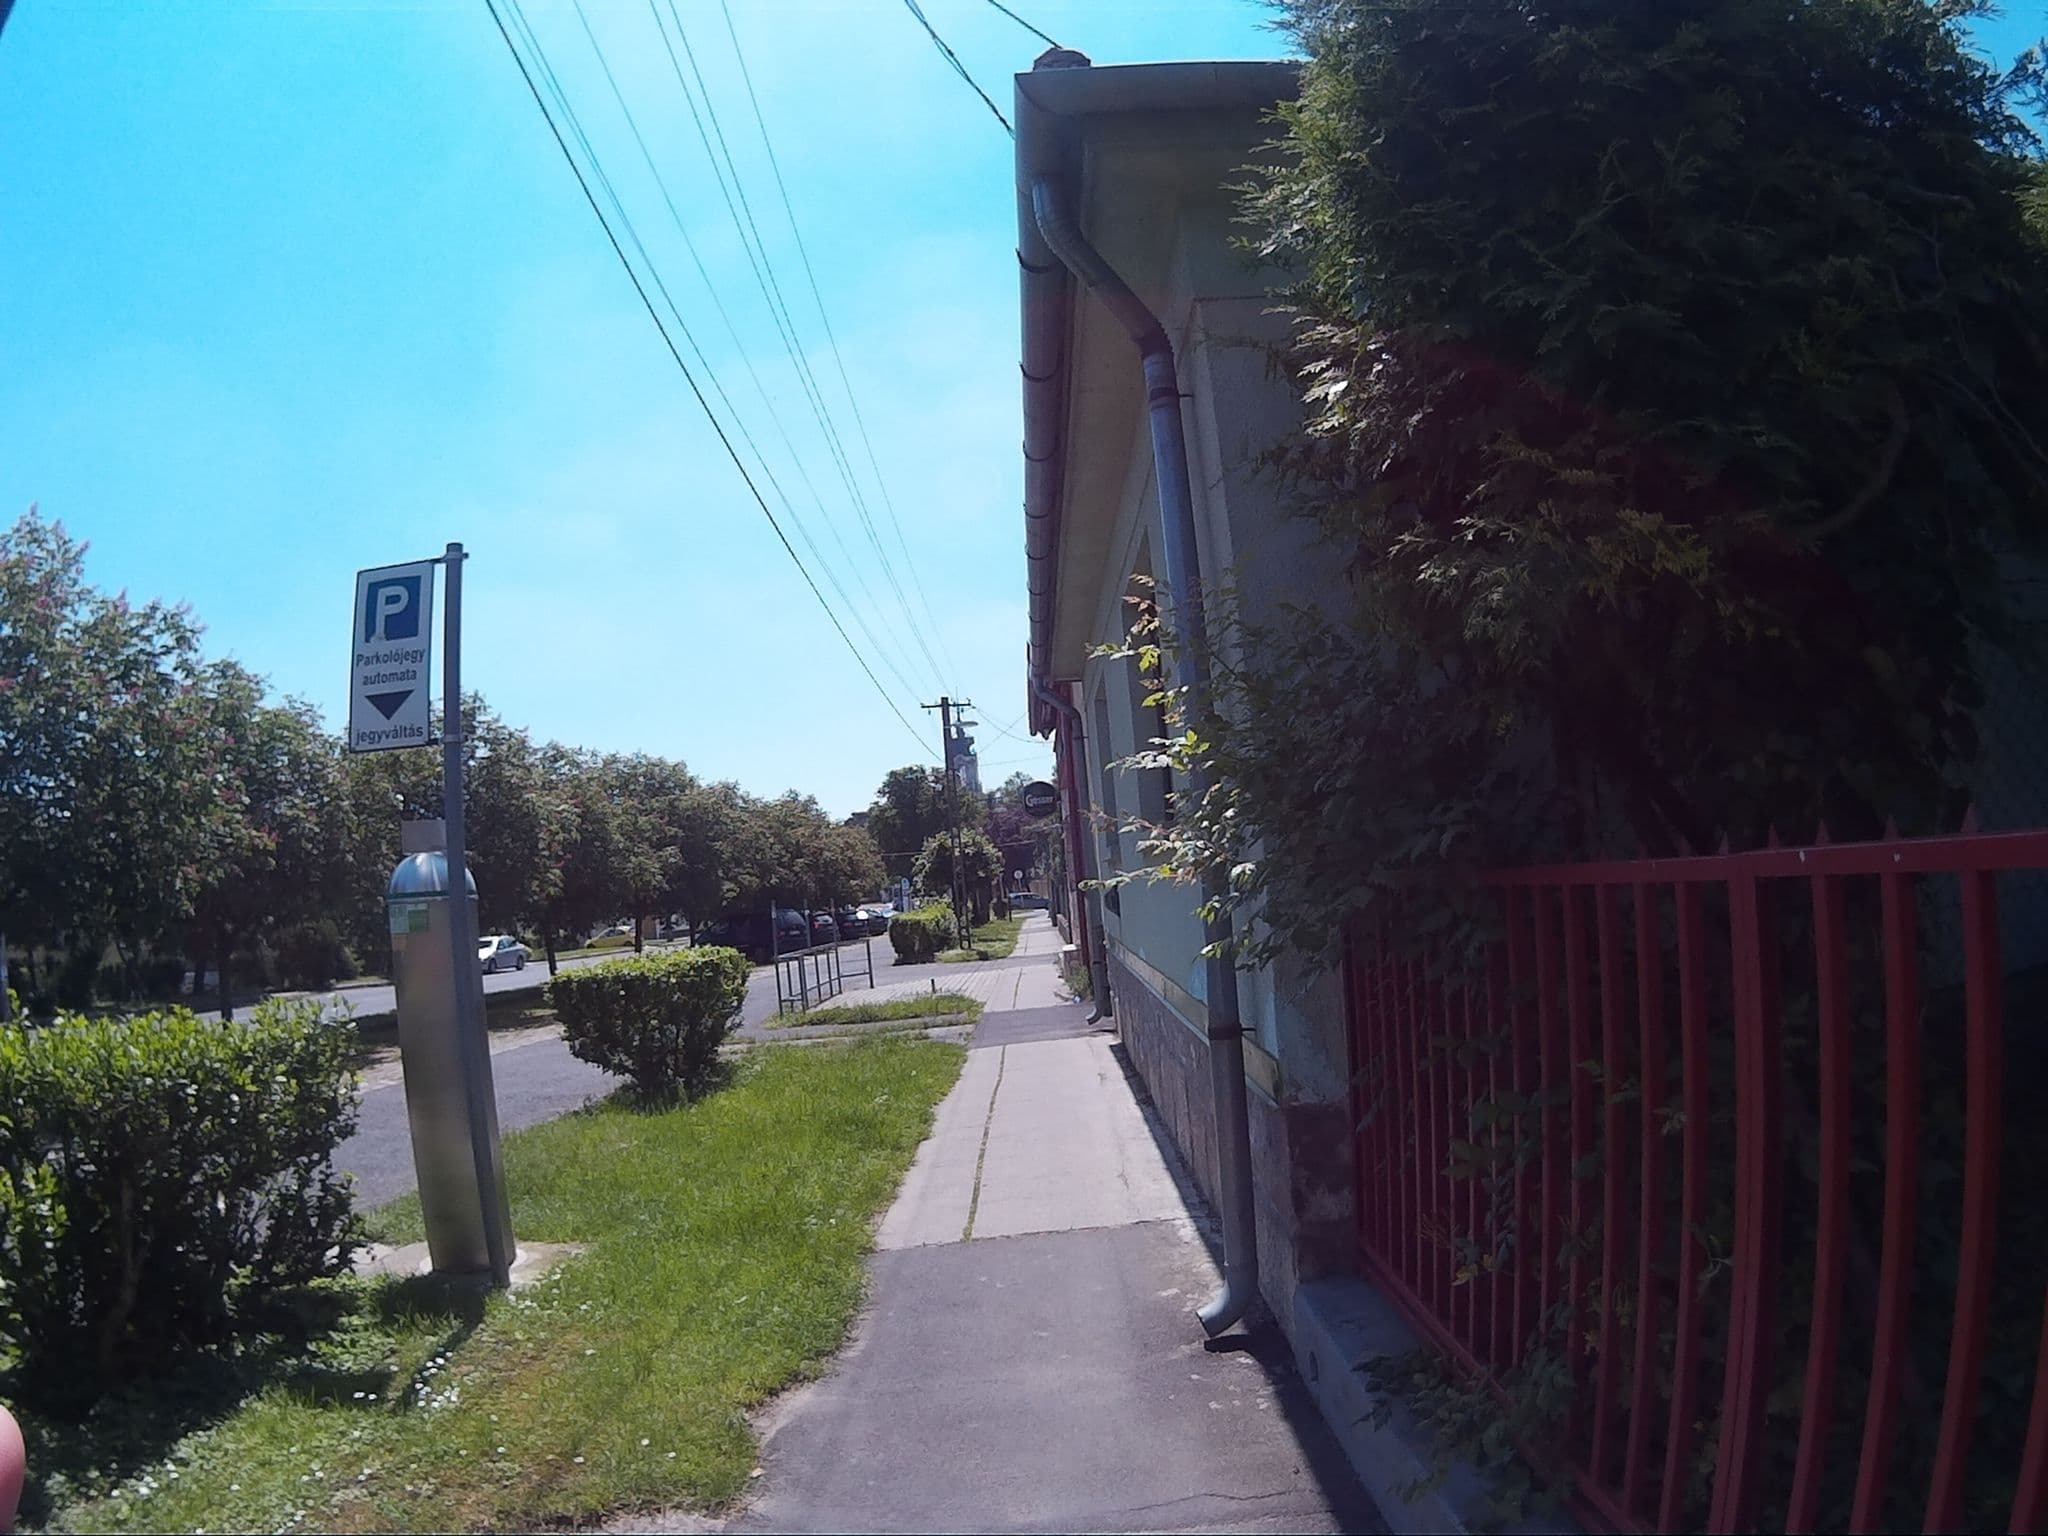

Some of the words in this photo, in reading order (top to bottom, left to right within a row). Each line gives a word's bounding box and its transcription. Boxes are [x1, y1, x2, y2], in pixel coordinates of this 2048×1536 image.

[374, 585, 410, 641] P
[356, 647, 425, 667] Parkolójegy
[362, 669, 417, 686] automata
[355, 725, 424, 746] jegyváltás
